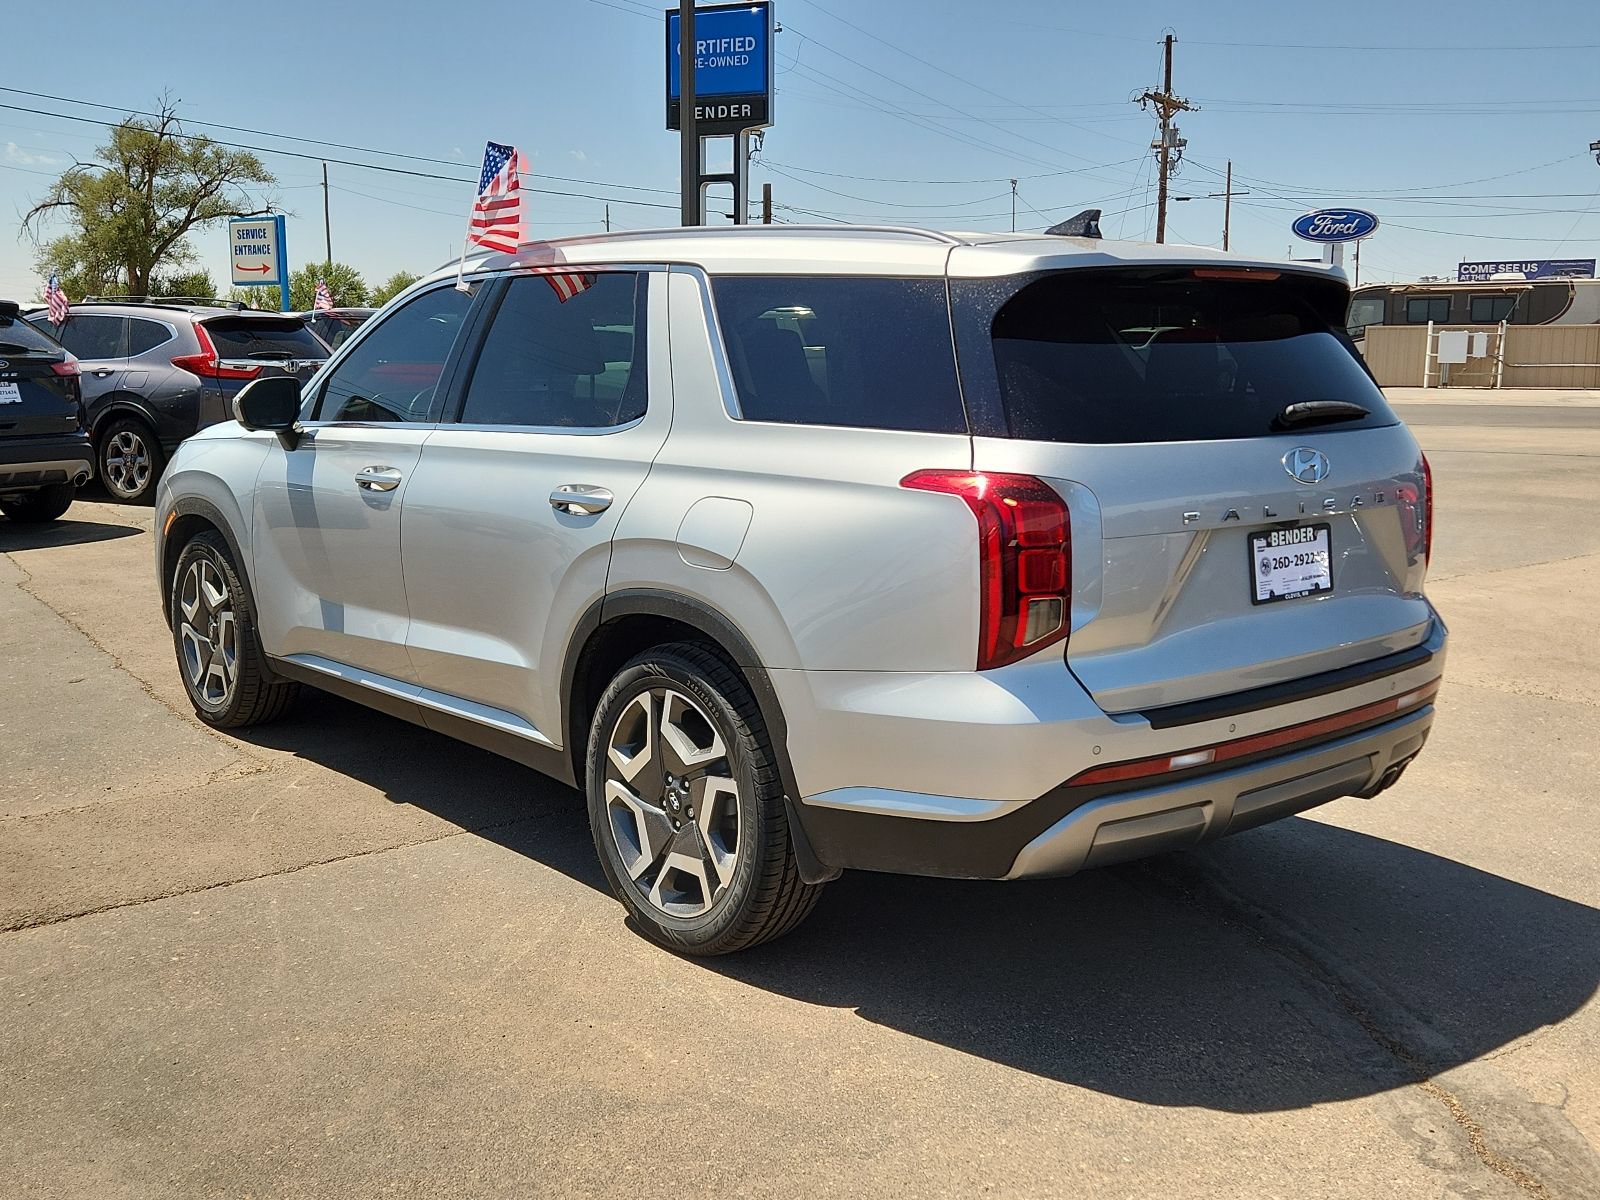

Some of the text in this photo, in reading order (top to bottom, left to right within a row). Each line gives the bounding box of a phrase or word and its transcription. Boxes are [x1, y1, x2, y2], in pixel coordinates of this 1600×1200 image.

[677, 37, 756, 55] RTIFIED
[694, 104, 751, 119] ENDER
[1309, 215, 1360, 235] Ford
[236, 228, 267, 239] SERVICE
[234, 244, 271, 255] ENTRANCE
[1460, 263, 1538, 274] COME SEE US
[1271, 527, 1314, 546] BENDER
